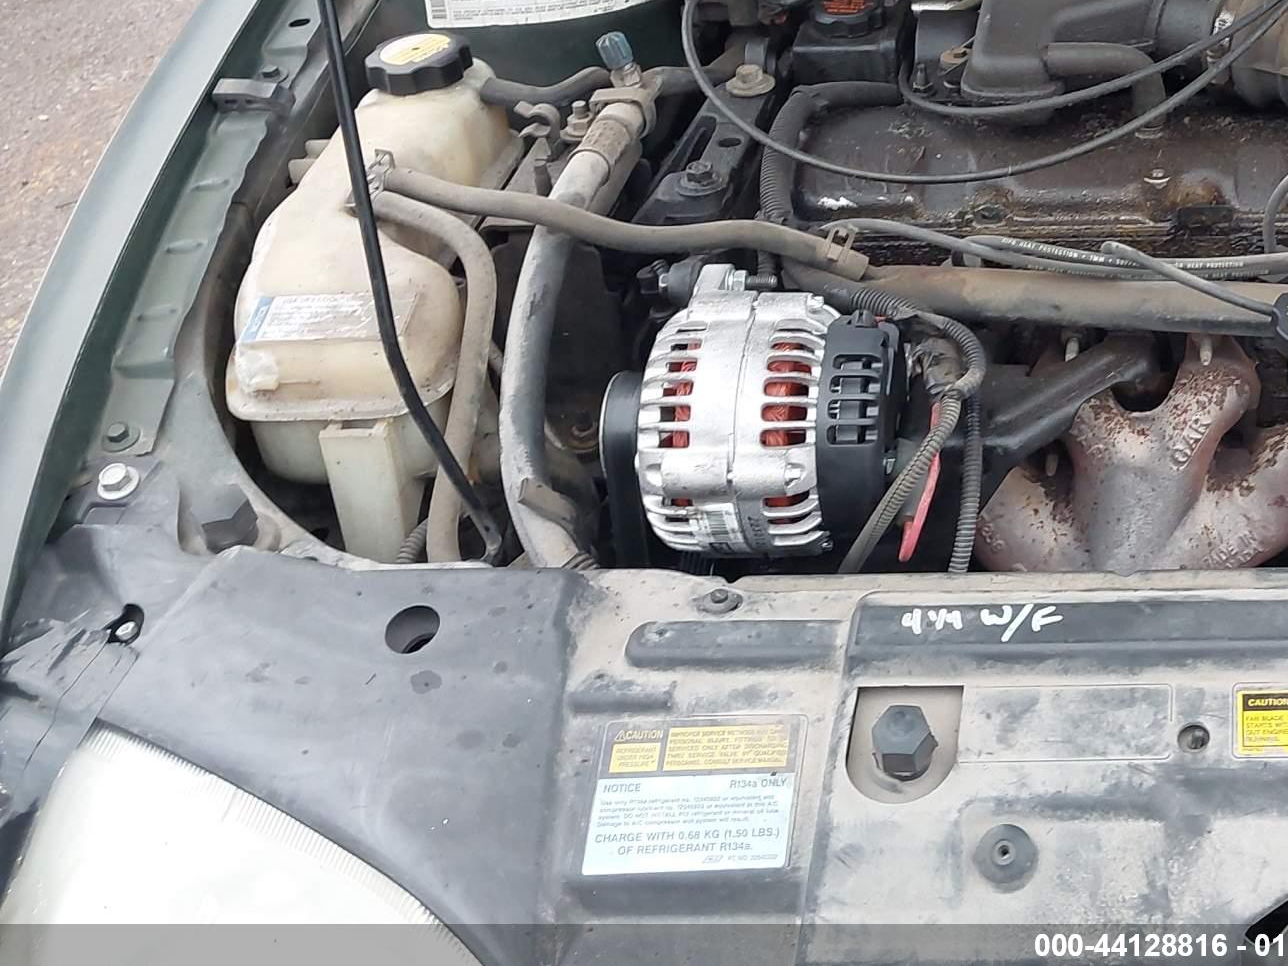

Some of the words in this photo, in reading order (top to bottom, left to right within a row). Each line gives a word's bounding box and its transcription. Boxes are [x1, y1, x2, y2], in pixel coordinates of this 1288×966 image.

[626, 729, 664, 740] CAUTION
[603, 783, 642, 793] NOTICE
[760, 778, 788, 788] ONLY
[594, 833, 643, 843] CHARGE
[646, 831, 674, 841] WITH
[678, 830, 700, 840] 0.68
[703, 829, 720, 839] KG
[724, 828, 749, 839] (1.50
[617, 846, 634, 855] OF
[636, 843, 717, 855] REFRIGERANT
